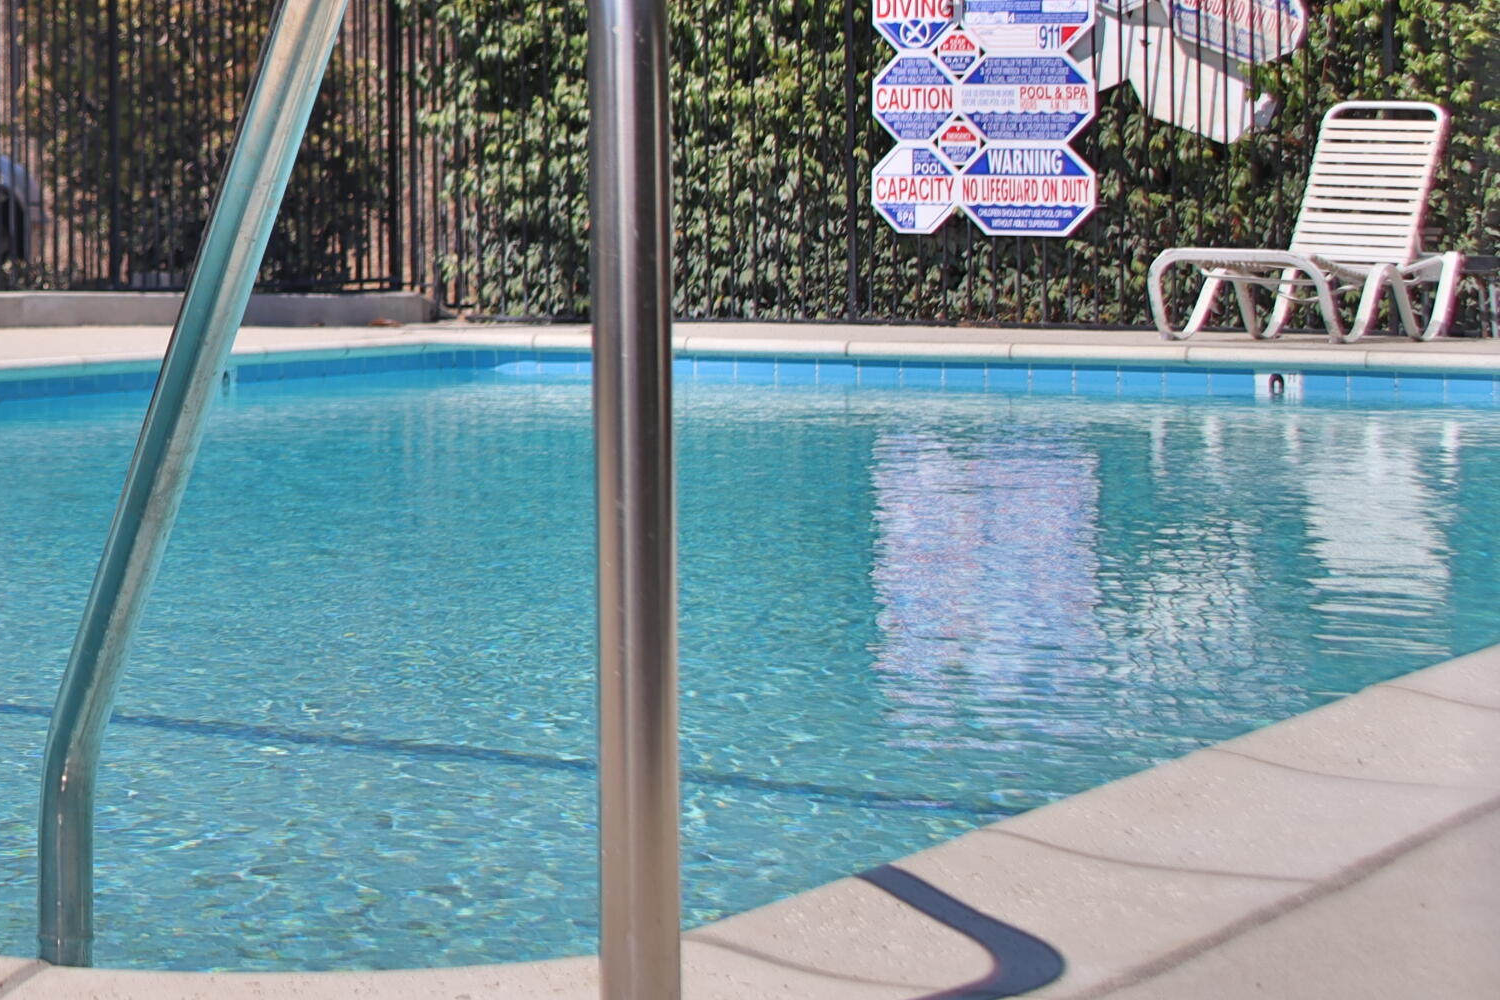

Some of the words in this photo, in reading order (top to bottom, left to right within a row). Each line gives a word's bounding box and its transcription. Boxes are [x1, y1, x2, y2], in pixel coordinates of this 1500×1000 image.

[1039, 25, 1061, 49] 911
[876, 87, 953, 110] CAUTION
[1019, 86, 1051, 99] POOL
[1055, 86, 1062, 99] &
[1065, 86, 1088, 99] SPA
[914, 163, 945, 174] POOL
[987, 149, 1063, 175] WARNING
[876, 177, 955, 201] CAPACITY
[962, 178, 978, 201] NO
[982, 179, 1038, 202] LIFEGUARD
[1042, 179, 1057, 202] ON
[1062, 179, 1090, 202] DUTY
[896, 211, 914, 223] SPA
